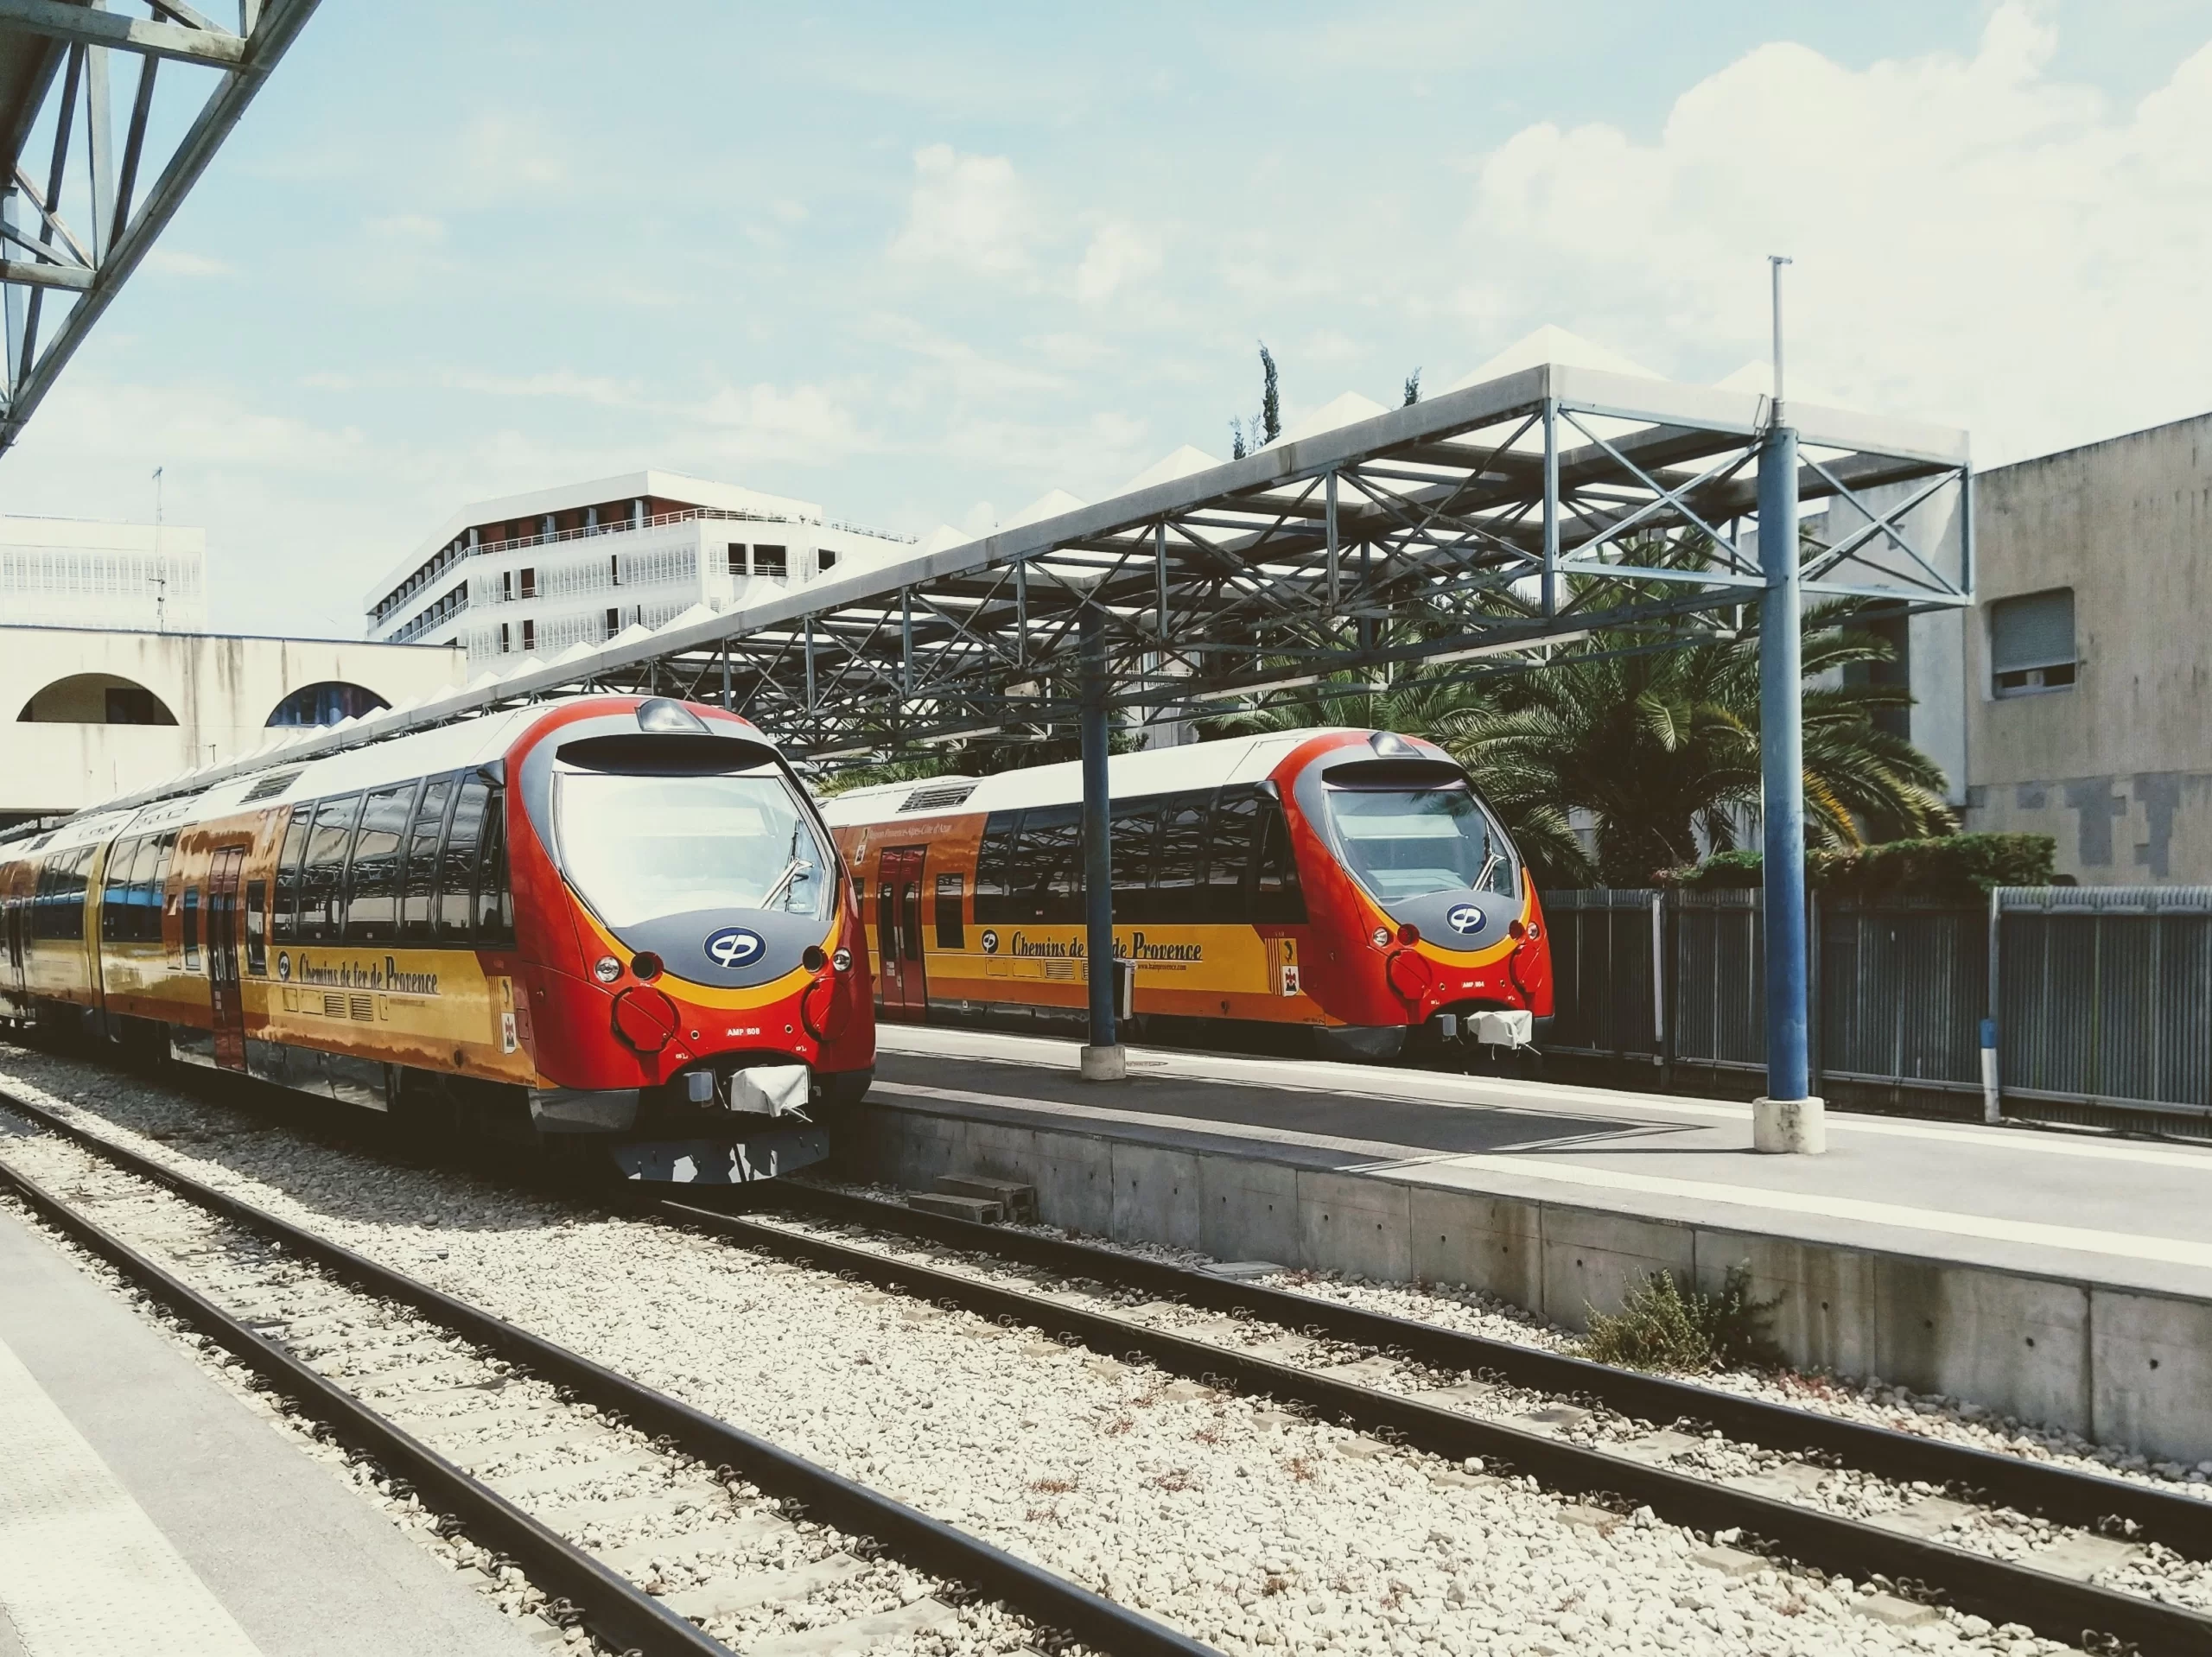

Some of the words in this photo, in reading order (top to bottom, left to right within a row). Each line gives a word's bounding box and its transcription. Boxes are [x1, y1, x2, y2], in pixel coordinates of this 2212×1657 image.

[1012, 930, 1065, 956] Chemins
[1070, 936, 1084, 956] de
[1112, 937, 1128, 958] de
[1132, 931, 1202, 960] Provence
[299, 953, 339, 986] Chemins
[340, 962, 351, 987] de
[354, 961, 367, 988] fer
[371, 962, 382, 990] de
[385, 955, 438, 994] Provence
[727, 1028, 744, 1037] AMP
